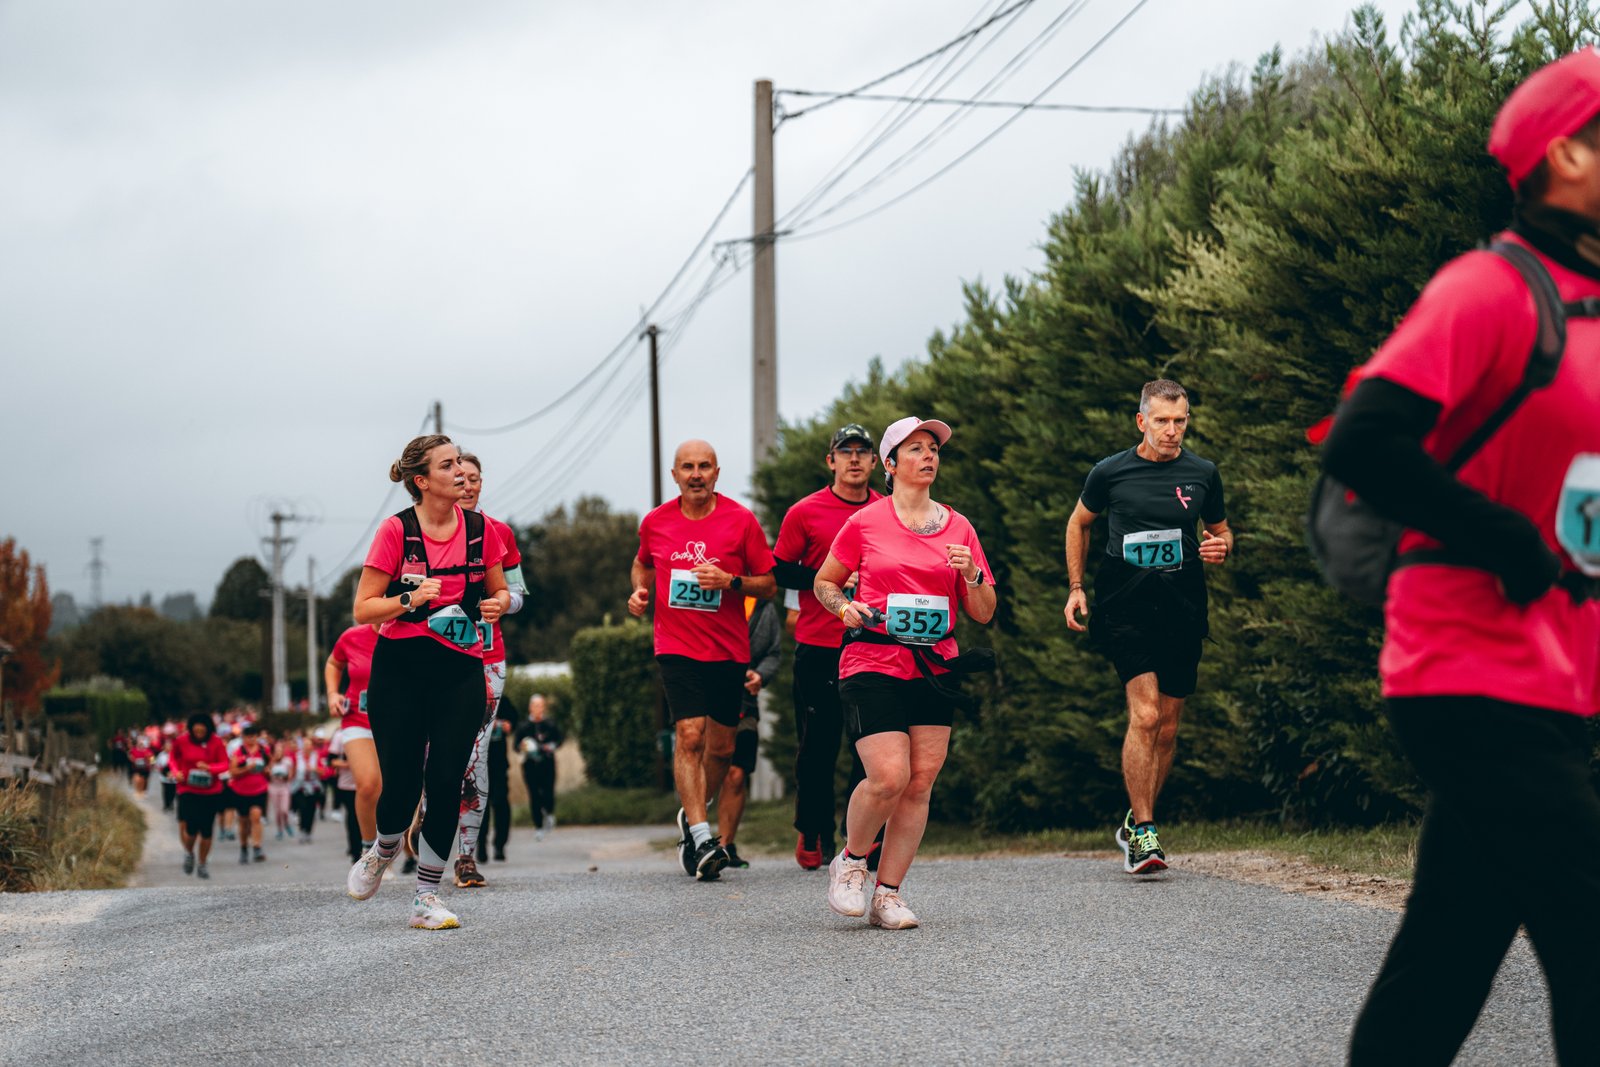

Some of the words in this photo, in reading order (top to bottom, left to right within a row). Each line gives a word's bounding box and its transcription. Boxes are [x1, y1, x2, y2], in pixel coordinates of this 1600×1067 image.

[1132, 543, 1175, 565] 178
[675, 582, 715, 603] 250
[442, 619, 468, 641] 47
[894, 609, 943, 635] 352
